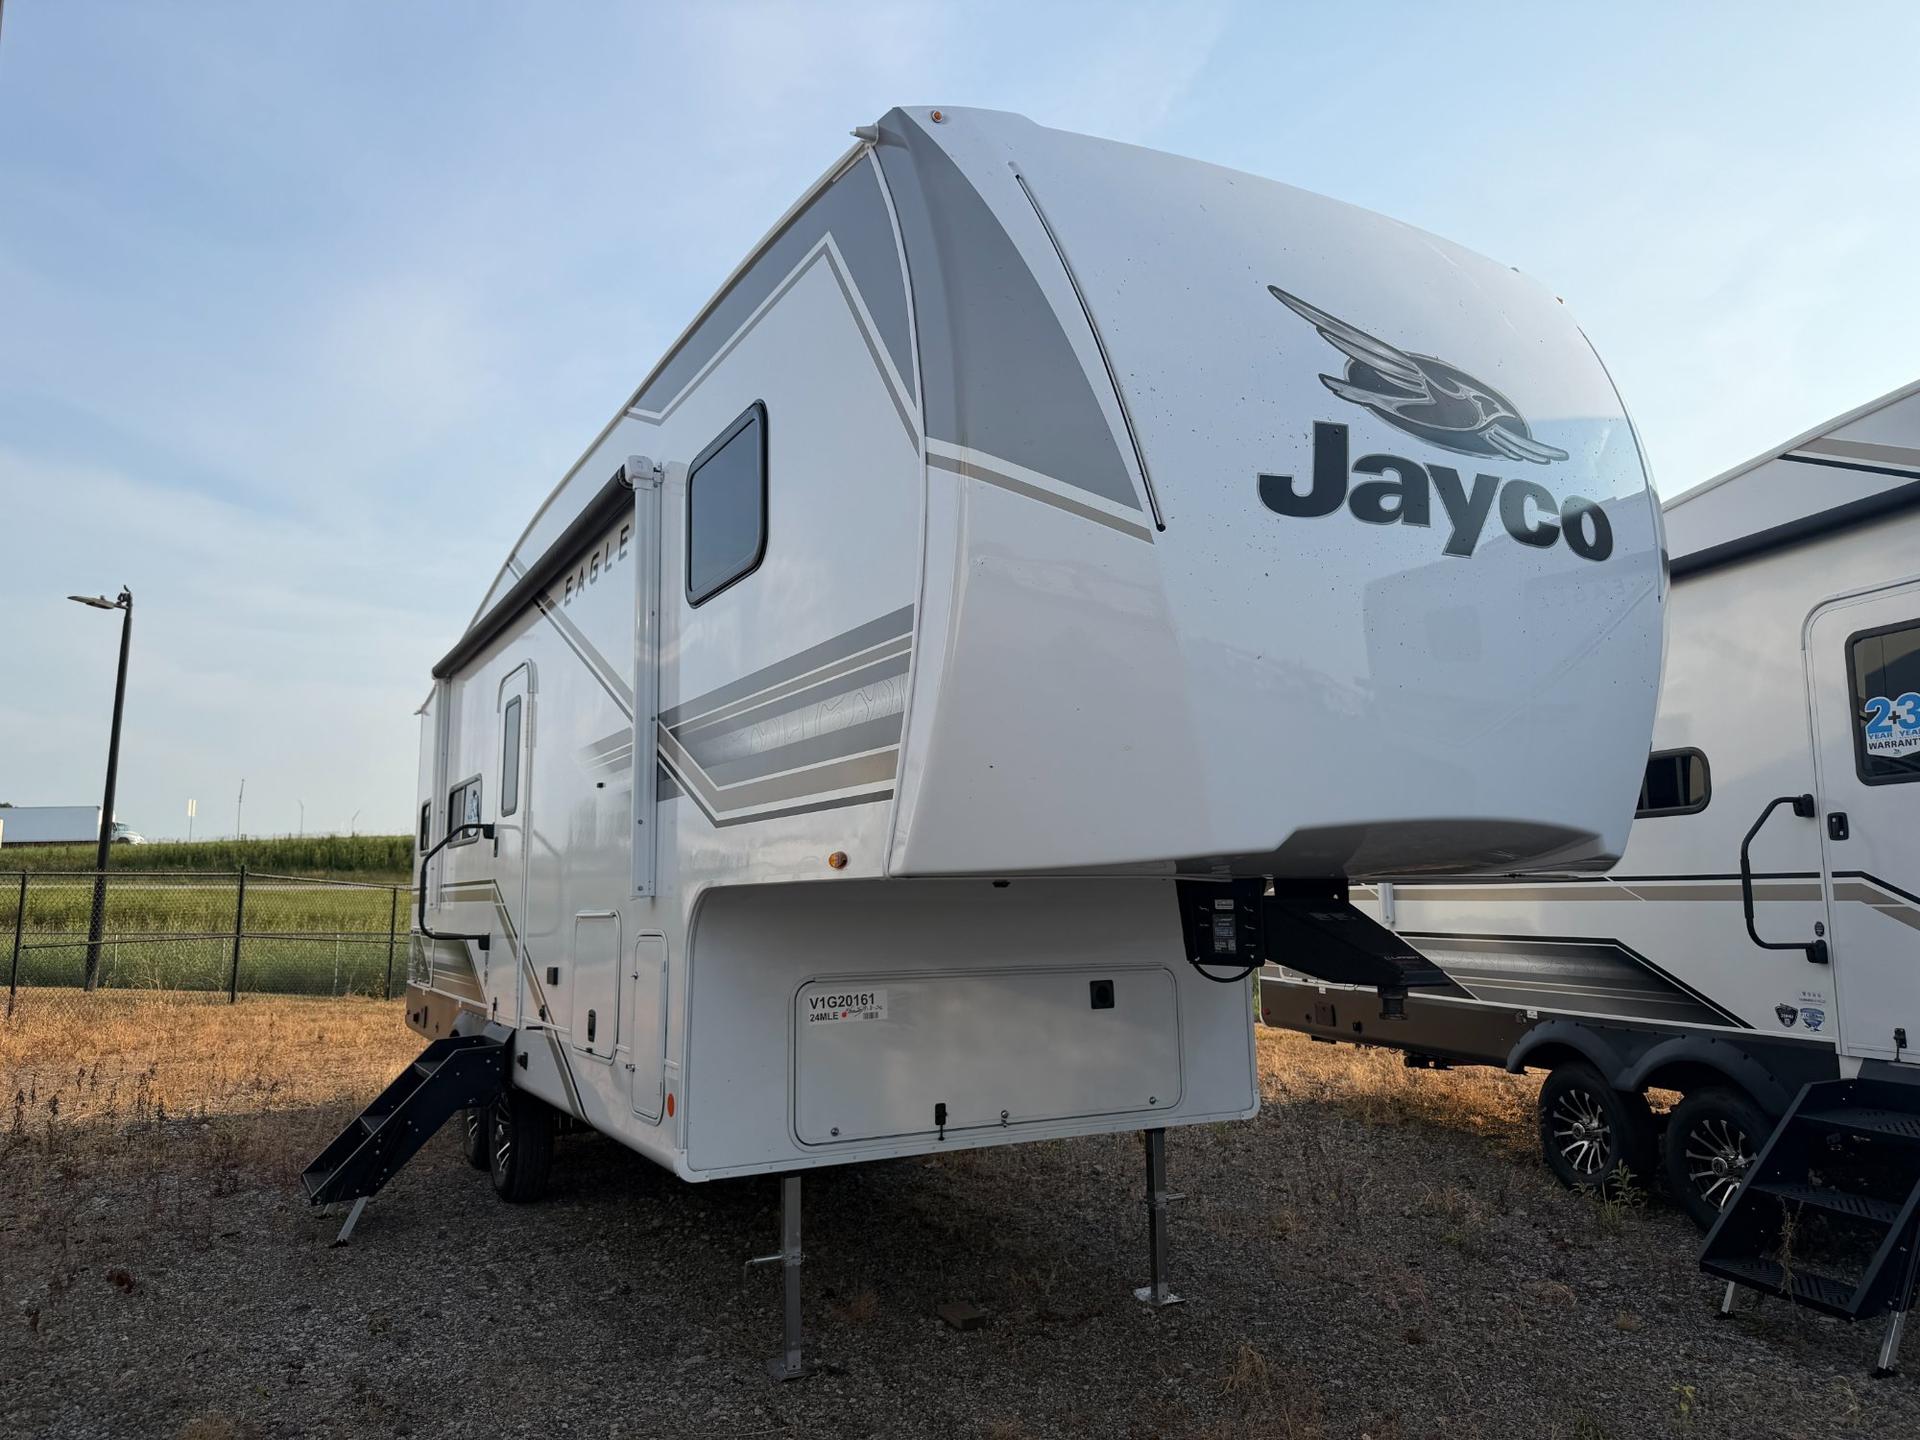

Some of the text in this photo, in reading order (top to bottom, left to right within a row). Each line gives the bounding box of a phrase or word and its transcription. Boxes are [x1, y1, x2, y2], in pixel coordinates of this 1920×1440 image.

[1257, 420, 1614, 562] Jayco
[563, 523, 630, 607] EAGLE
[1868, 729, 1920, 740] YEAR YEA
[1868, 737, 1920, 750] WARRANT
[809, 992, 875, 1010] V1G20161
[809, 1011, 839, 1022] 24MLE
